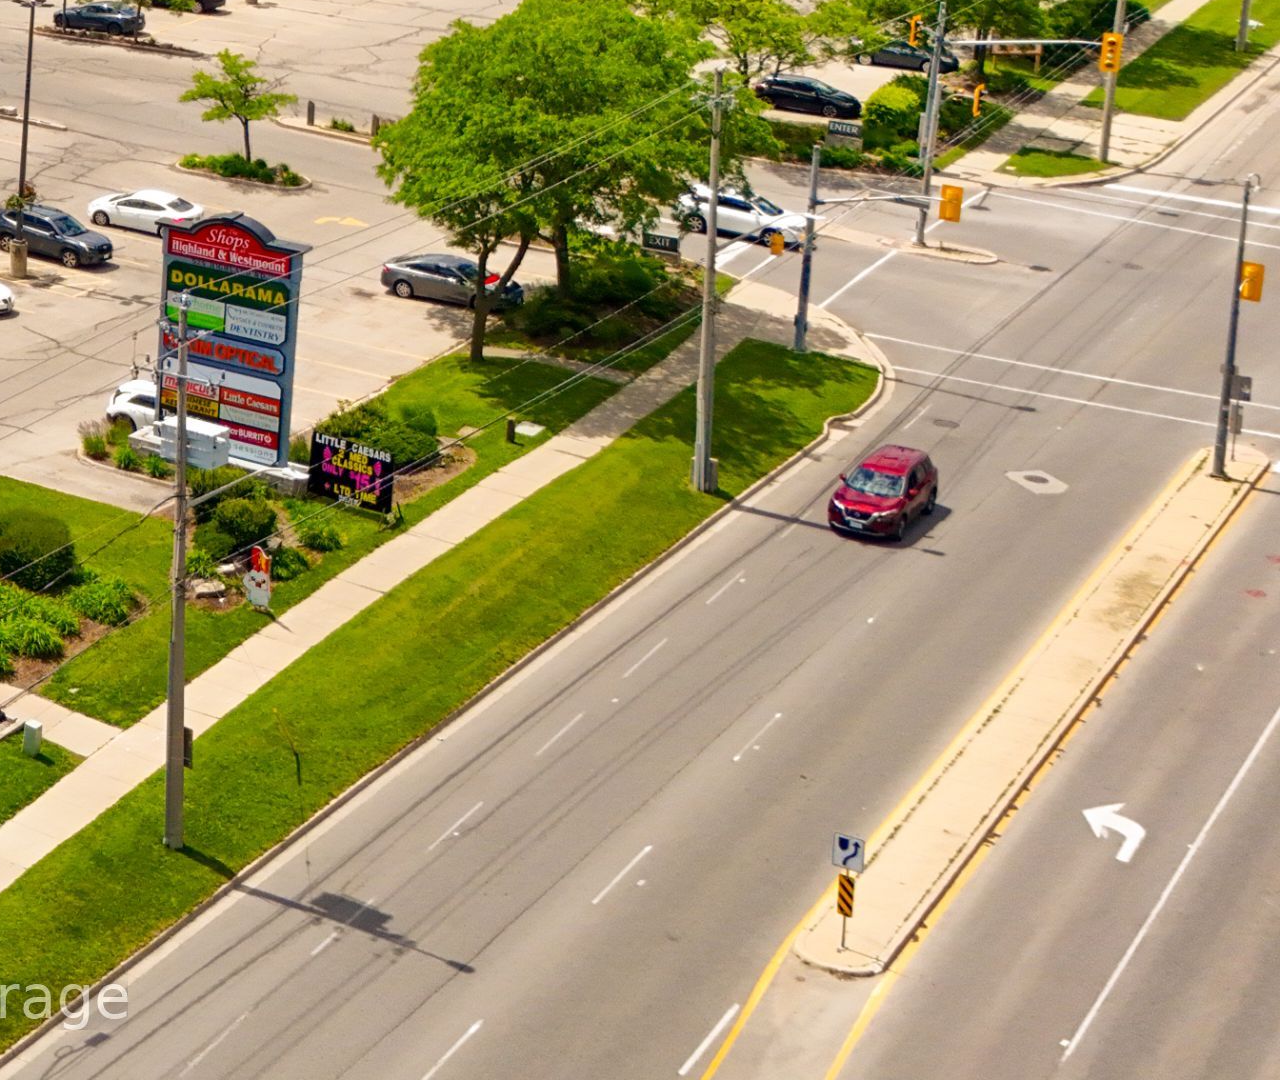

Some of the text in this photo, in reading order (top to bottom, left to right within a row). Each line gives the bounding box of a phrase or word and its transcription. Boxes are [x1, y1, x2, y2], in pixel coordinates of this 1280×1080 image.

[830, 122, 859, 135] ENTER
[206, 228, 250, 252] Shops
[649, 235, 671, 248] EXIT
[172, 239, 216, 259] Highland
[217, 248, 228, 261] &
[229, 251, 287, 274] Westmount
[170, 268, 286, 307] DOLLARAMA
[229, 323, 280, 342] DENTISTRY
[214, 344, 281, 375] OPTICAL
[223, 391, 279, 413] Little Caesars
[316, 432, 392, 463] LITTLE CAESARS
[349, 451, 369, 466] MED
[331, 454, 374, 476] CLASSICS
